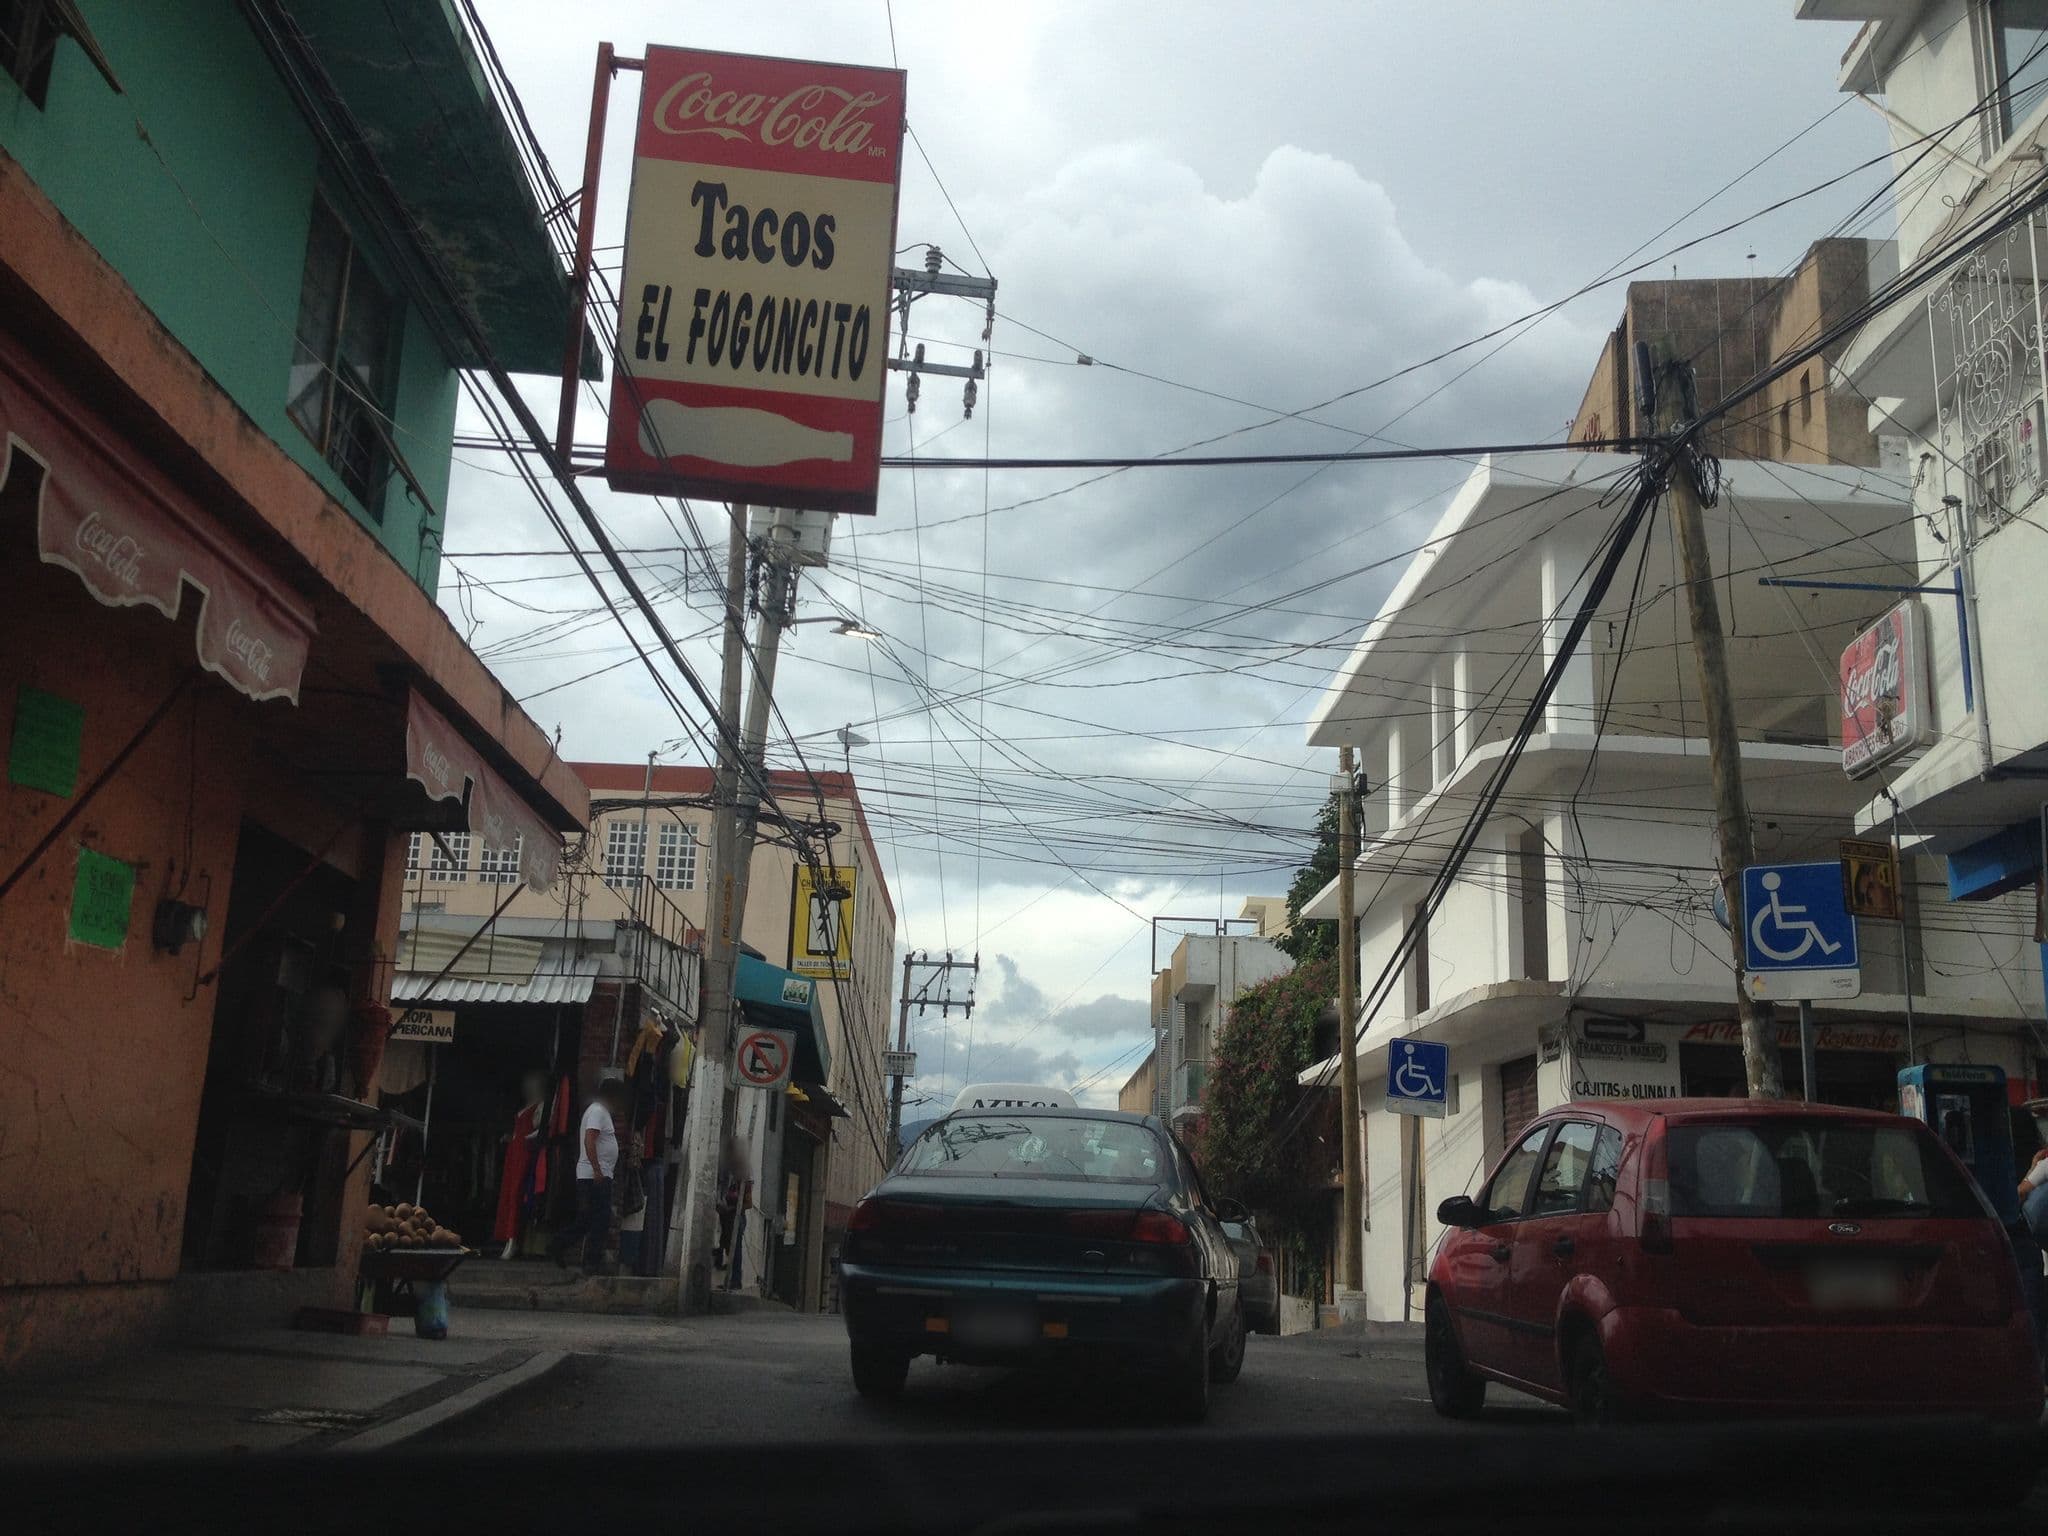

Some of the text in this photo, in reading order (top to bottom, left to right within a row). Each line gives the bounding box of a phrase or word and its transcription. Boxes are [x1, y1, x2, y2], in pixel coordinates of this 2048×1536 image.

[653, 71, 889, 154] Coca-Cola
[868, 147, 887, 158] MR
[690, 180, 836, 270] Tacos
[635, 284, 870, 382] EL FOGONCITO
[394, 1024, 452, 1037] MERICANA
[1575, 1081, 1620, 1098] CAJITAS
[1621, 1086, 1630, 1098] de
